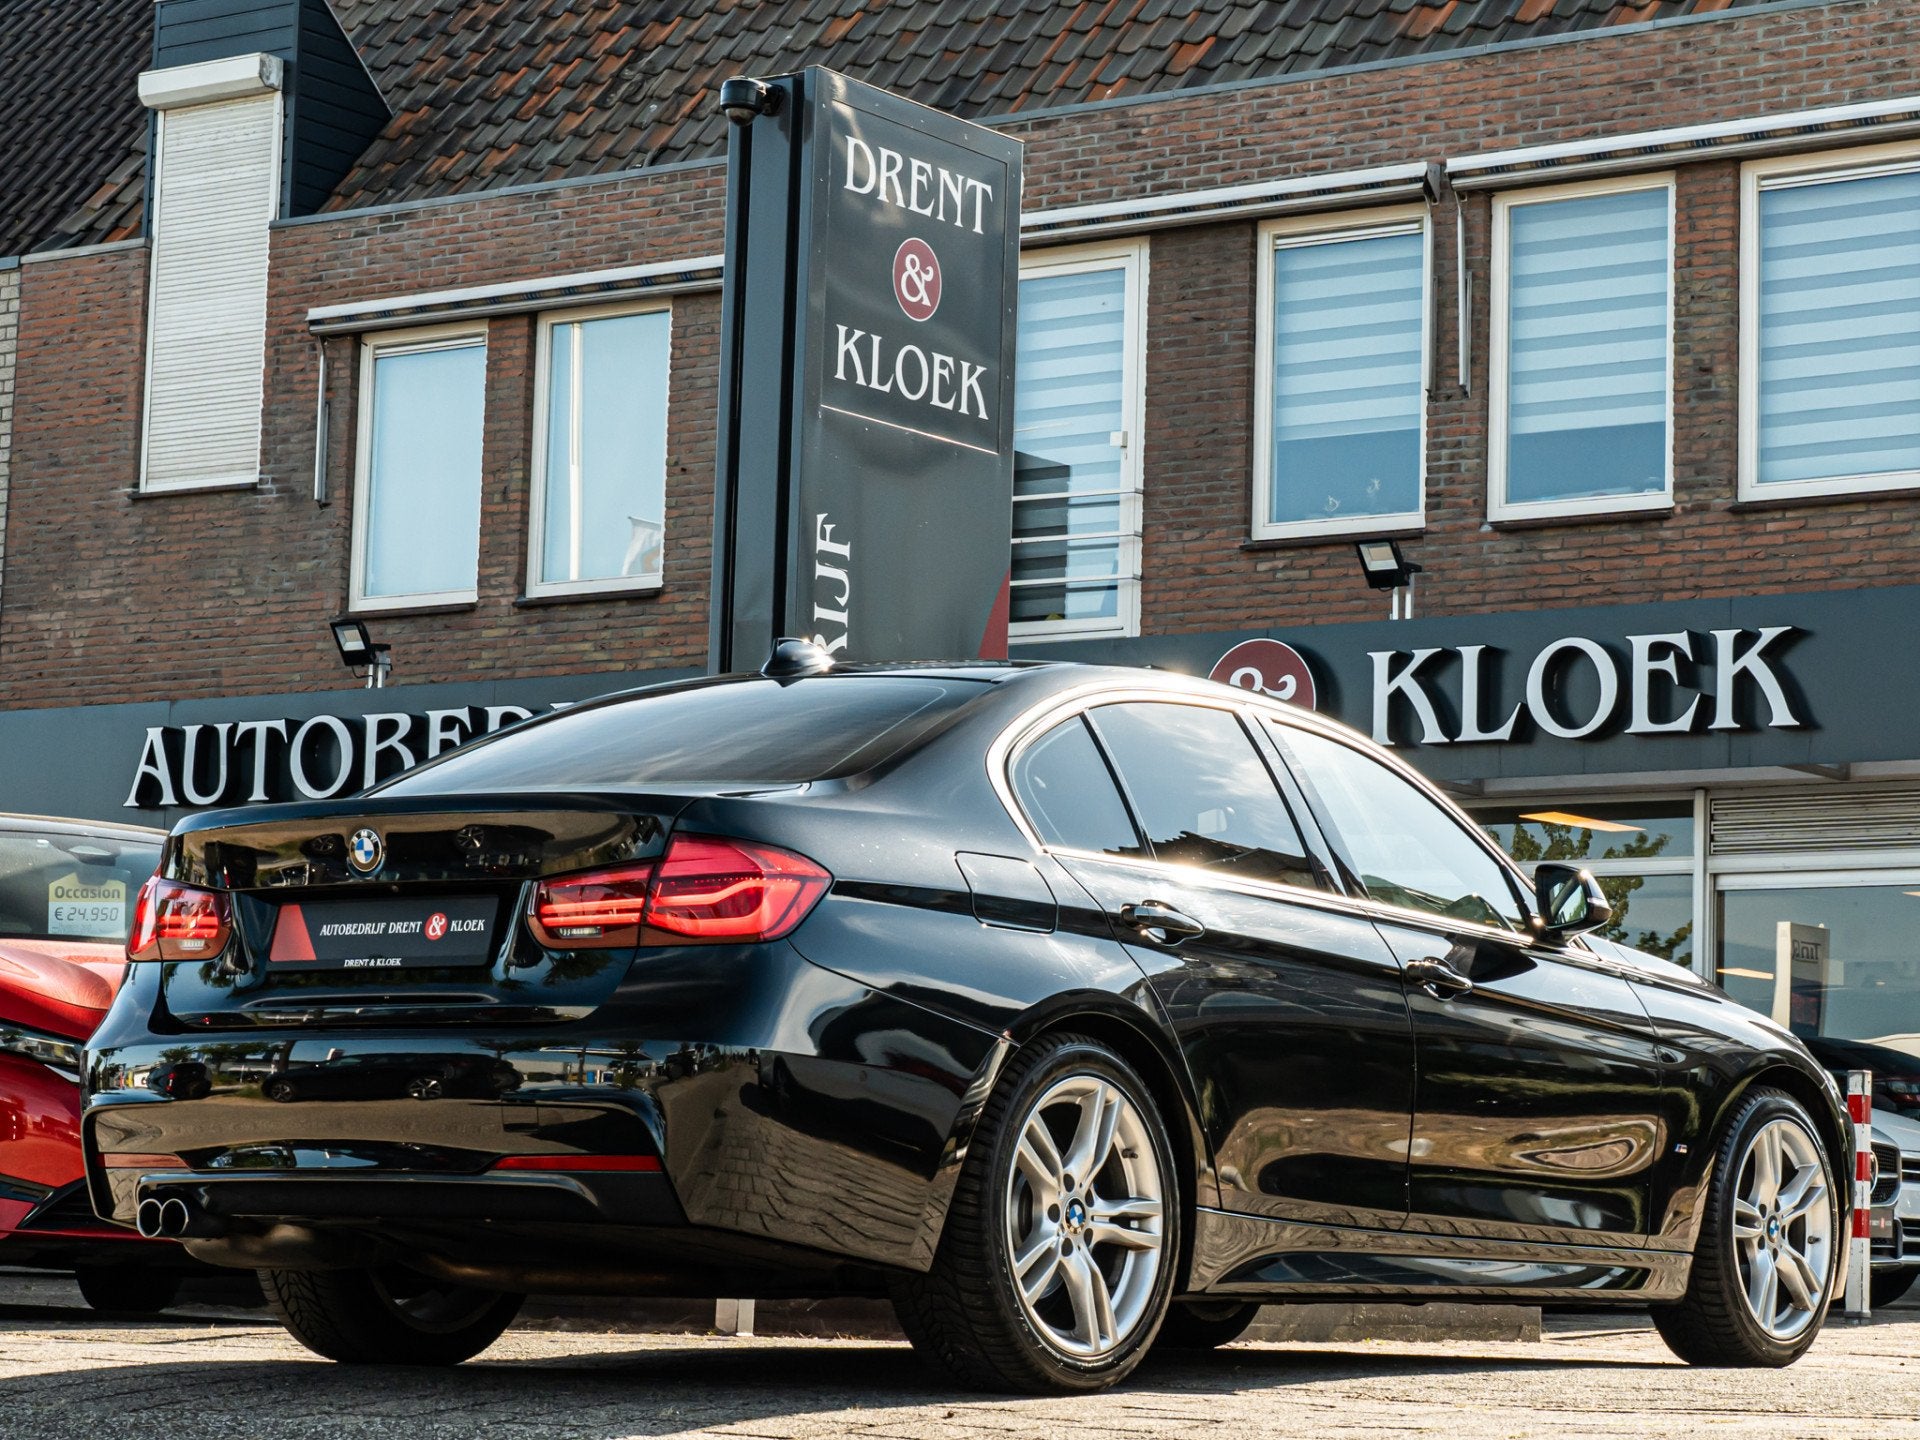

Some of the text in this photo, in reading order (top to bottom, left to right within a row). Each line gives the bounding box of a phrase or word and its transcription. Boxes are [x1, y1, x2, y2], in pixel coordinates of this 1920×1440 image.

[844, 135, 993, 235] DRENT
[901, 253, 934, 307] &
[834, 323, 989, 420] KLOEK
[123, 626, 1800, 807] AUTOBE KLOEK
[54, 885, 121, 899] Occasion
[66, 907, 119, 921] 24.950
[319, 915, 485, 936] AUTOBEDRIJF DRENT & KLOEK
[343, 958, 370, 968] DRENT
[375, 957, 402, 967] KLOEK
